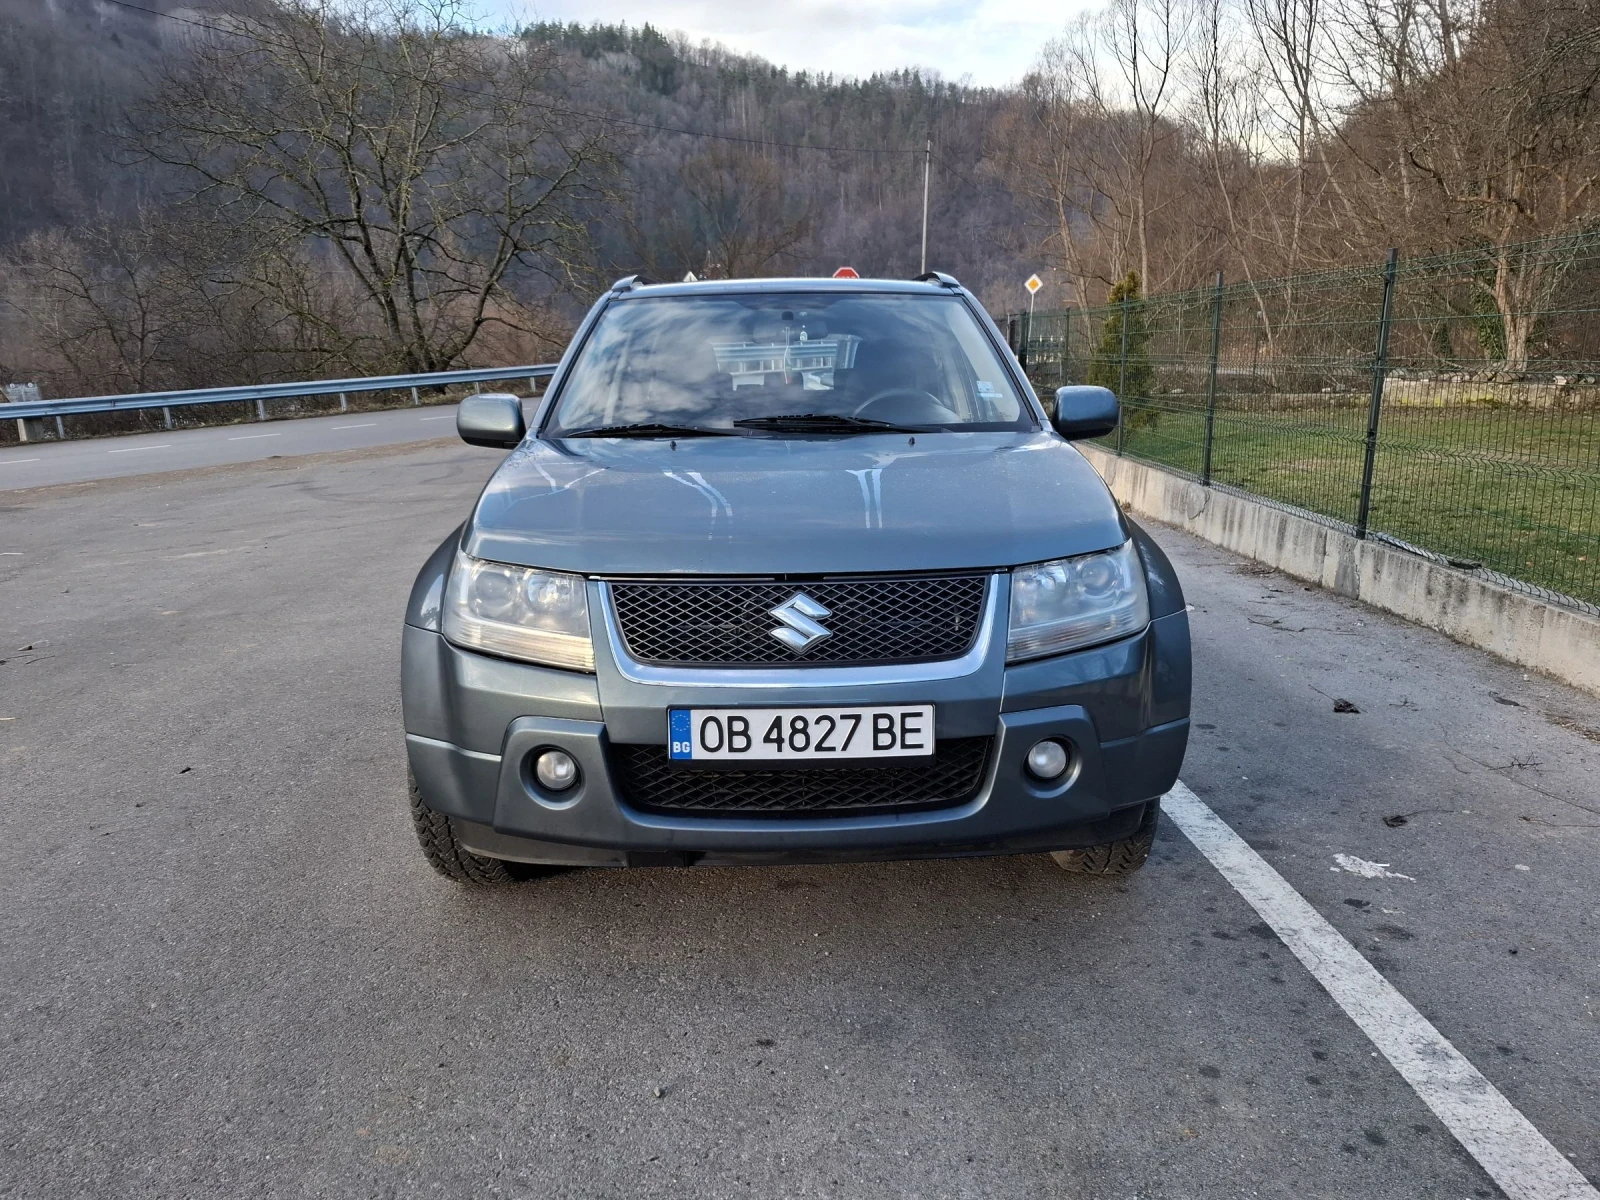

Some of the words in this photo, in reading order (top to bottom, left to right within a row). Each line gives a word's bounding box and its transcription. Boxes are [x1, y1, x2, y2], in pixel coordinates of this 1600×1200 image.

[700, 715, 751, 753] OB
[763, 713, 862, 752] 4827
[872, 711, 924, 750] BE
[673, 741, 690, 753] BG
